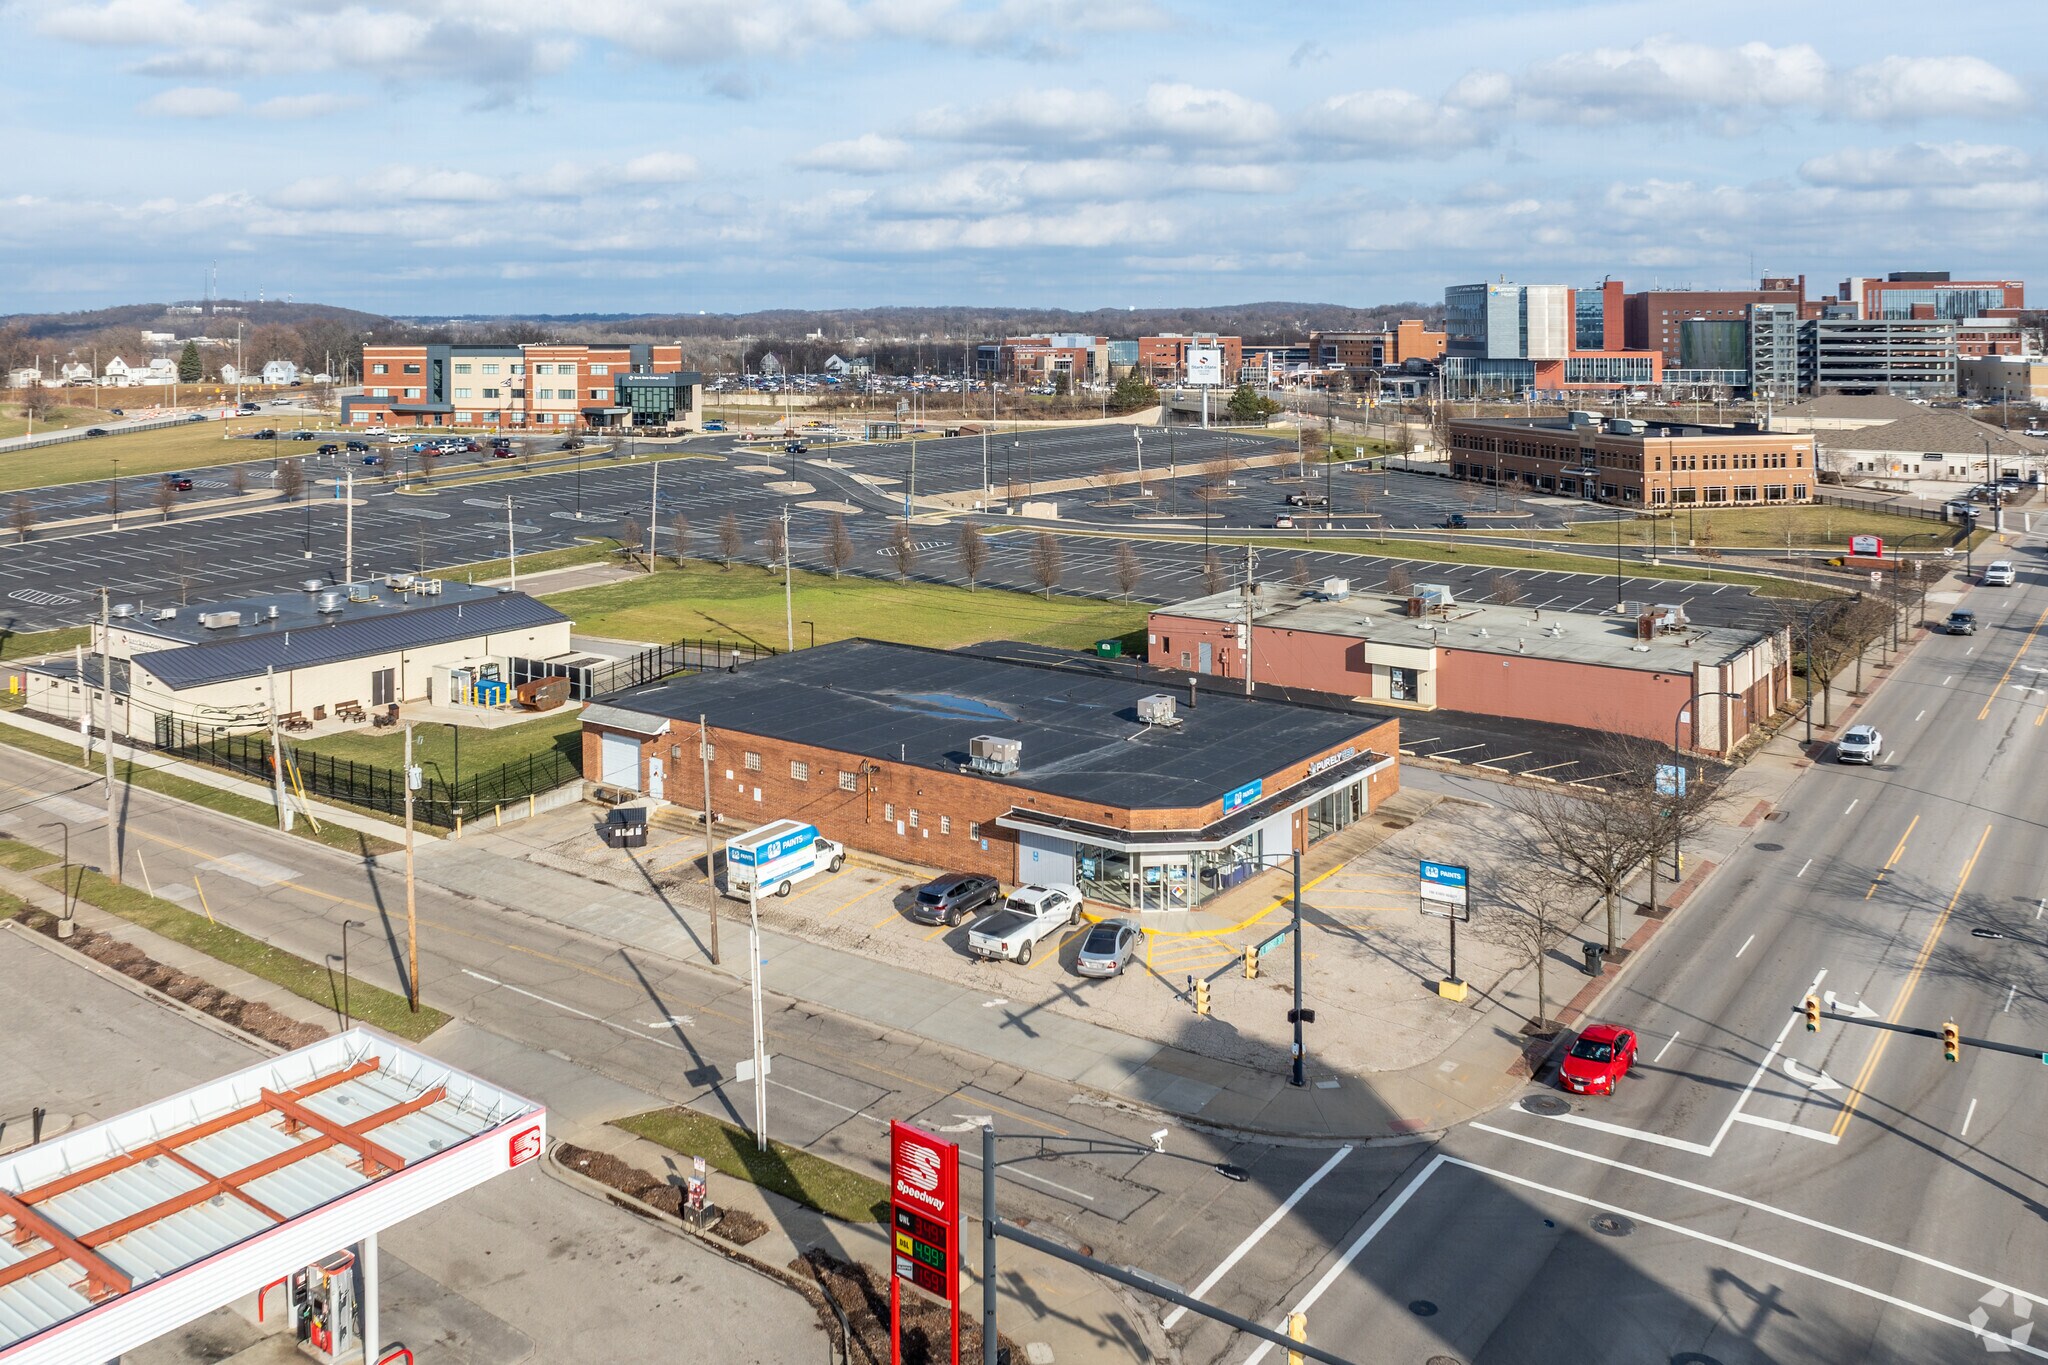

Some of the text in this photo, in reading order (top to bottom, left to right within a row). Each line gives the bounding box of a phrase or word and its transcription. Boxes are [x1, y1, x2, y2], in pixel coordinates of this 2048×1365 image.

[783, 835, 803, 850] PAINTS
[1440, 870, 1462, 880] PAINTS
[897, 1179, 945, 1211] Speedway
[899, 1238, 910, 1249] DSL
